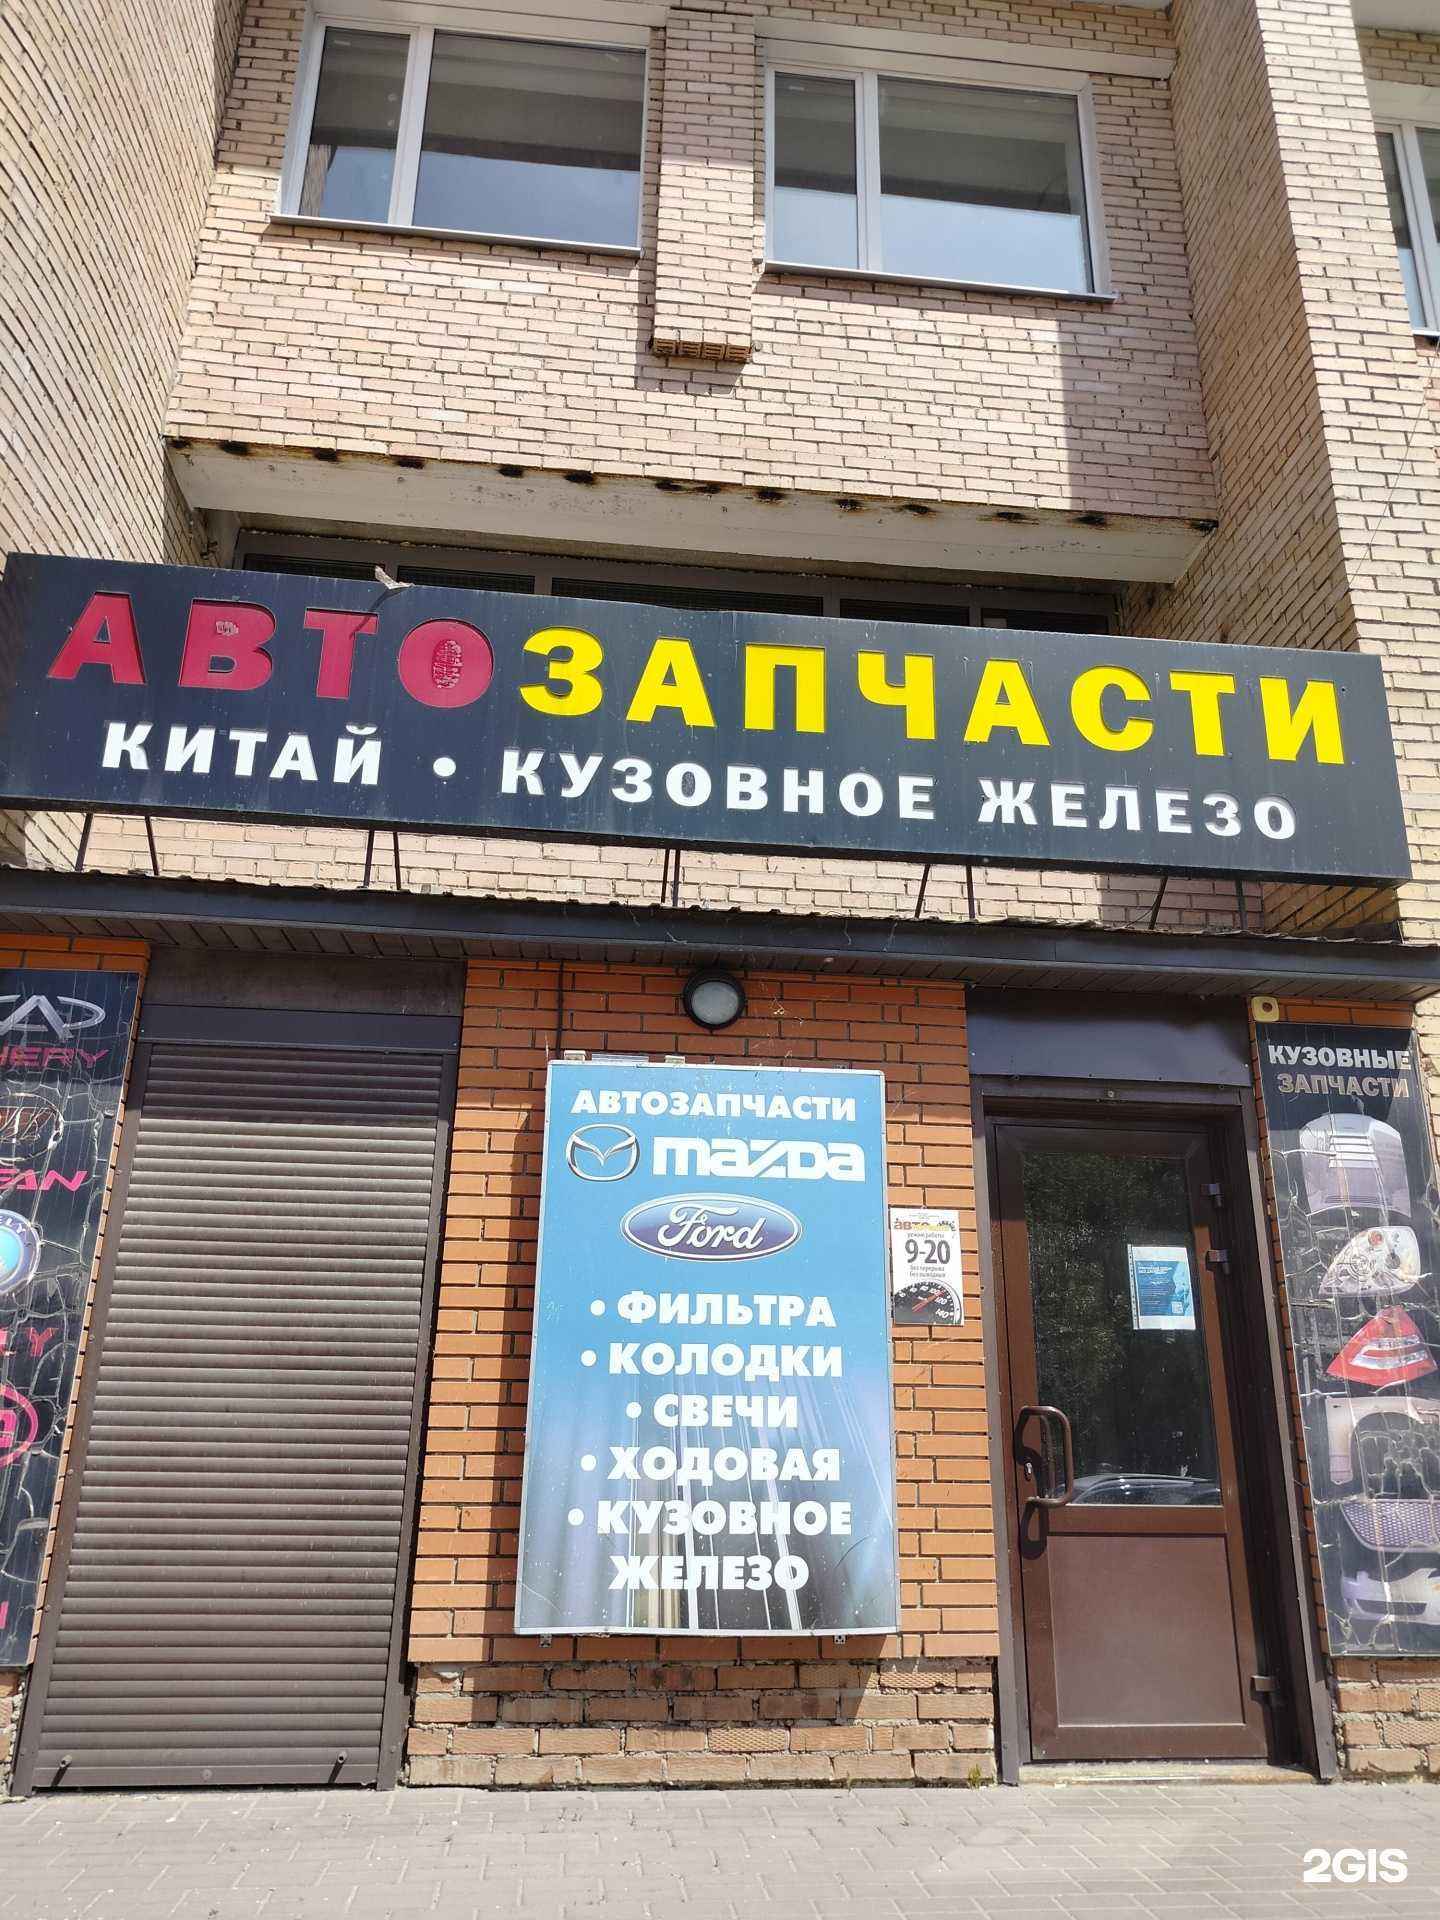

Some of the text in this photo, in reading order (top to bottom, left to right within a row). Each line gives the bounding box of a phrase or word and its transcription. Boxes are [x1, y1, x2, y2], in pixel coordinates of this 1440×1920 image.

[47, 591, 1345, 765] АВТОЗАПЧАСТИ
[102, 721, 1298, 840] КИТАЙ КУЗОВНОЕ ЖЕЛЕЗО
[1267, 1044, 1412, 1070] КУЗОВНЫЕ
[1277, 1073, 1410, 1098] ЗАПЧАСТИ
[570, 1090, 857, 1121] АВТОЗАПЧАСТИ
[657, 1203, 767, 1249] Ford
[905, 1239, 950, 1264] 9-20
[617, 1291, 837, 1327] ФИЛЬТРА
[608, 1343, 843, 1382] КОЛОДКИ
[653, 1393, 798, 1428] СВЕЧИ
[607, 1446, 841, 1486] ХОДОВАЯ
[597, 1500, 852, 1535] КУЗОВНОЕ
[608, 1554, 810, 1590] ЖЕЛЕЗО
